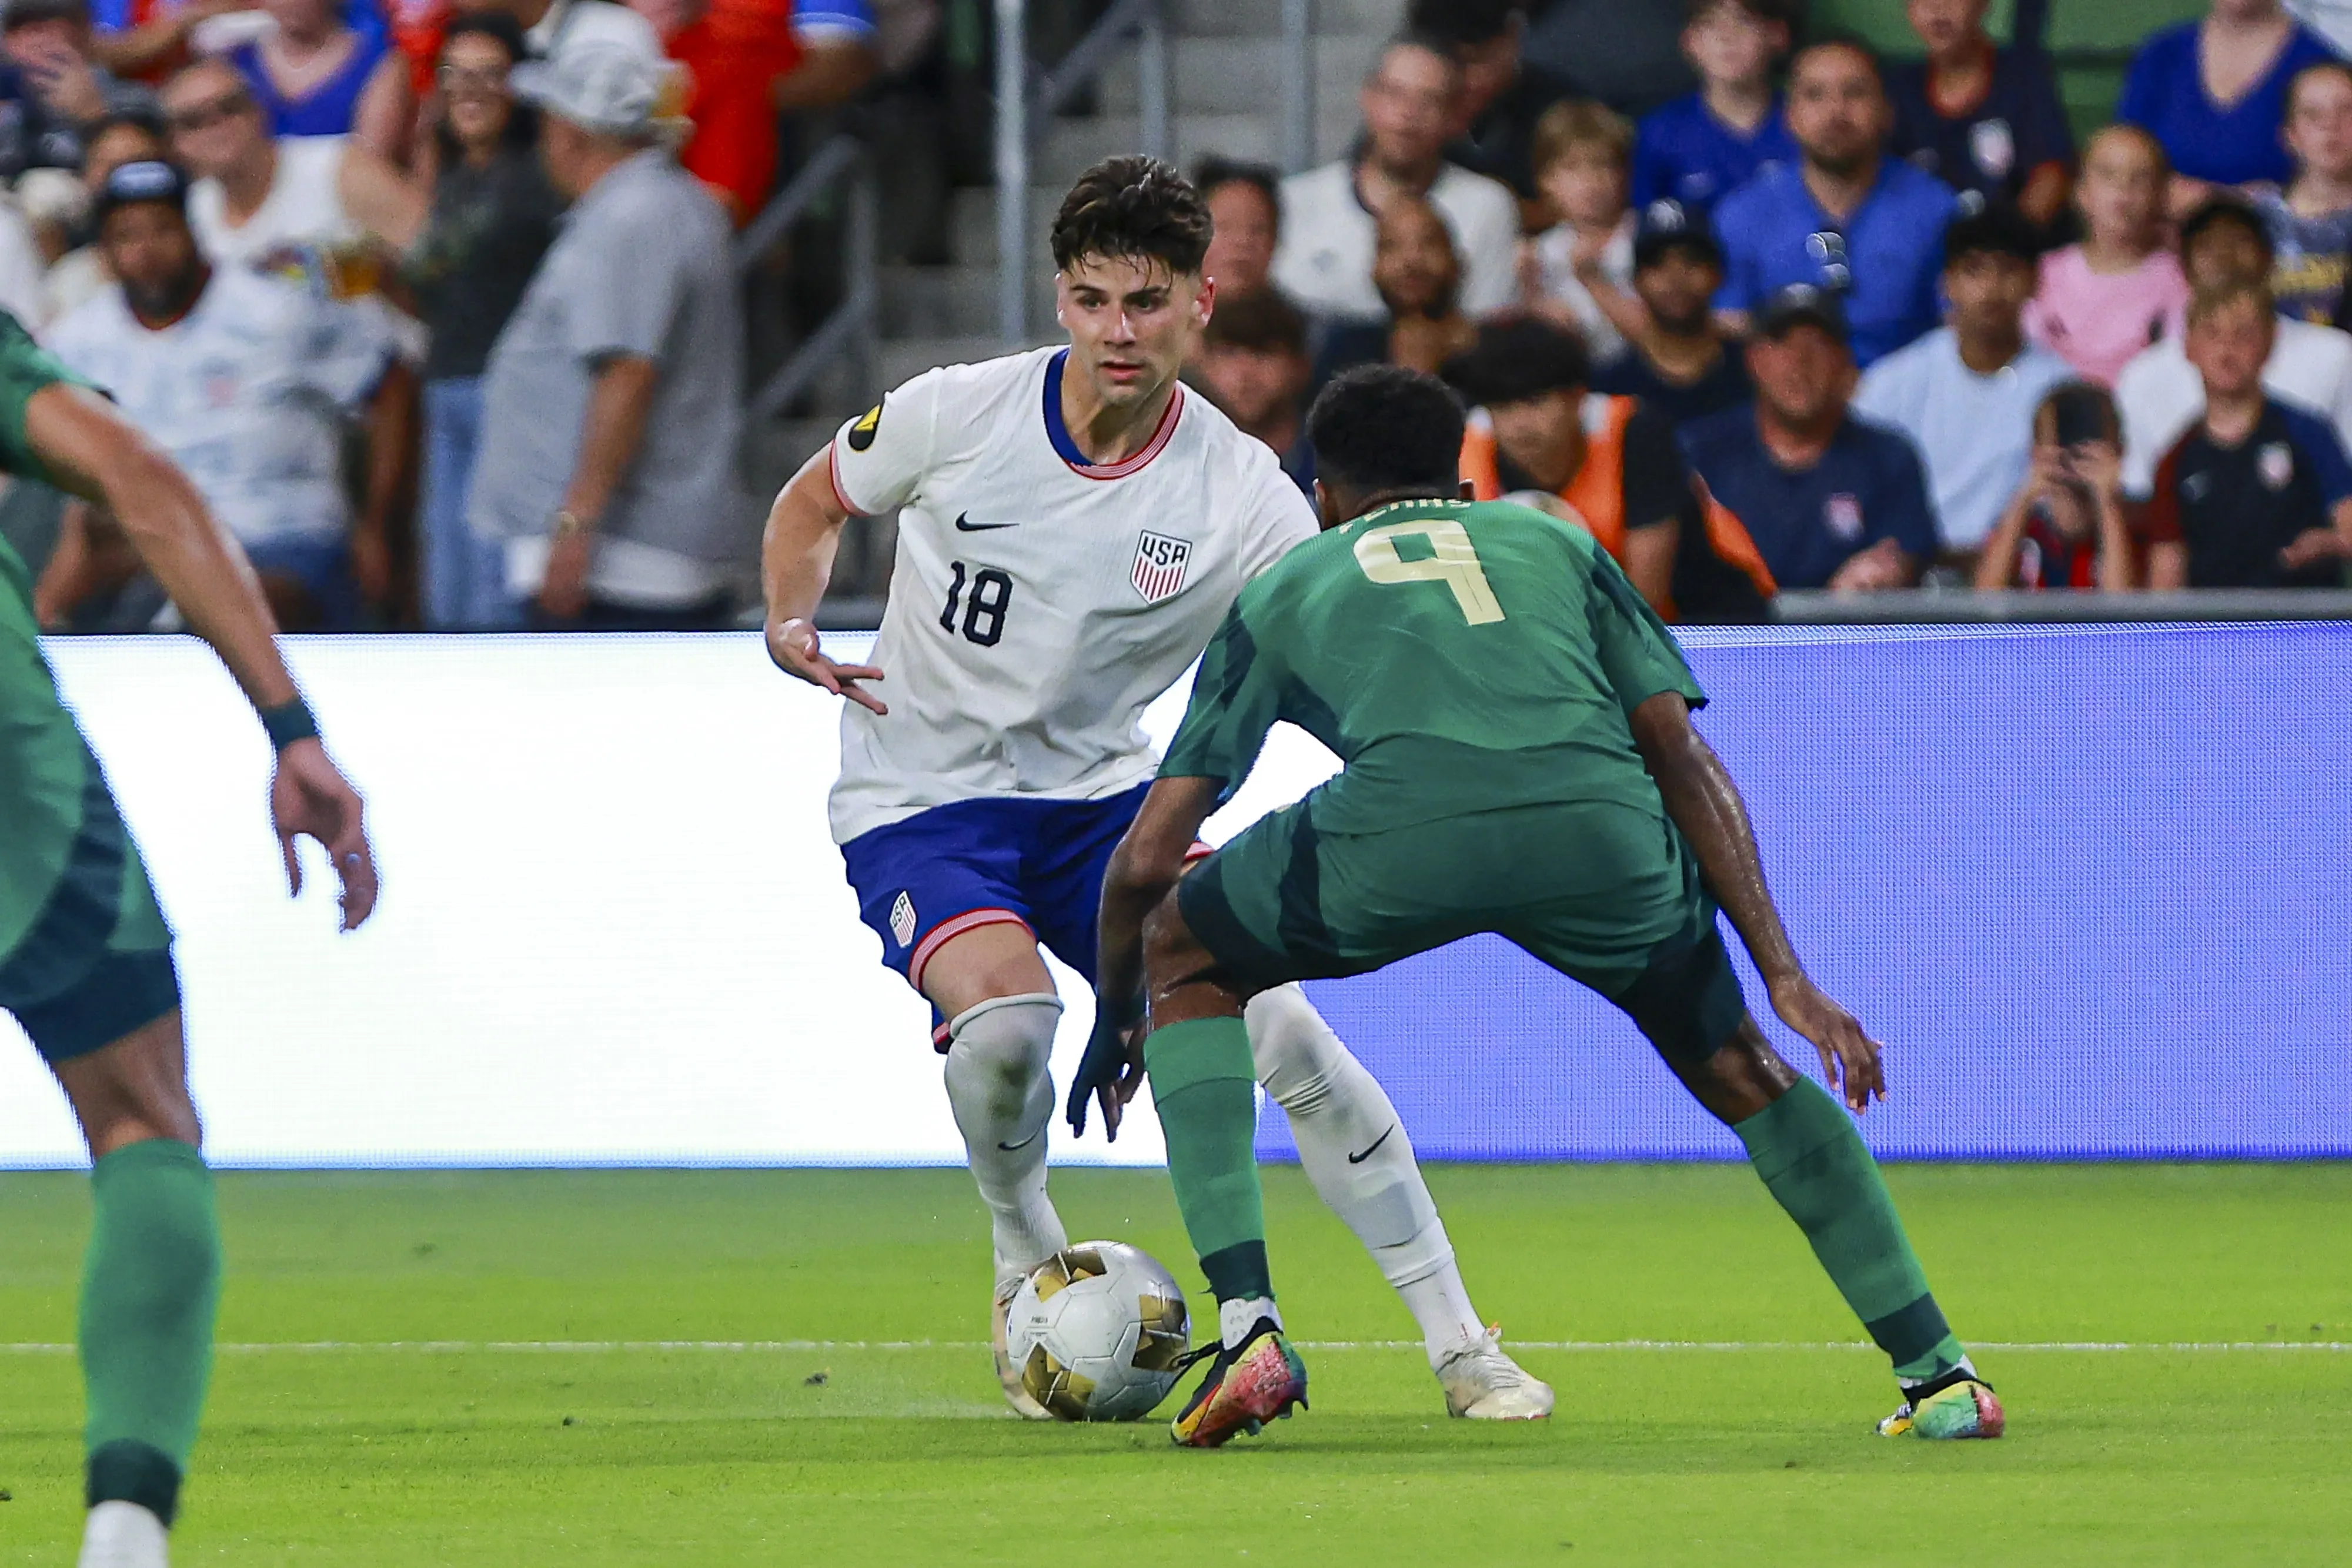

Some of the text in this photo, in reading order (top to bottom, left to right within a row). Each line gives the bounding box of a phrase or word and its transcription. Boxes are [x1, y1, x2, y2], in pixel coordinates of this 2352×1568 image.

[1141, 535, 1187, 566] USA
[1352, 519, 1505, 626] 9
[939, 560, 1014, 648] 18
[892, 896, 907, 927] USA
